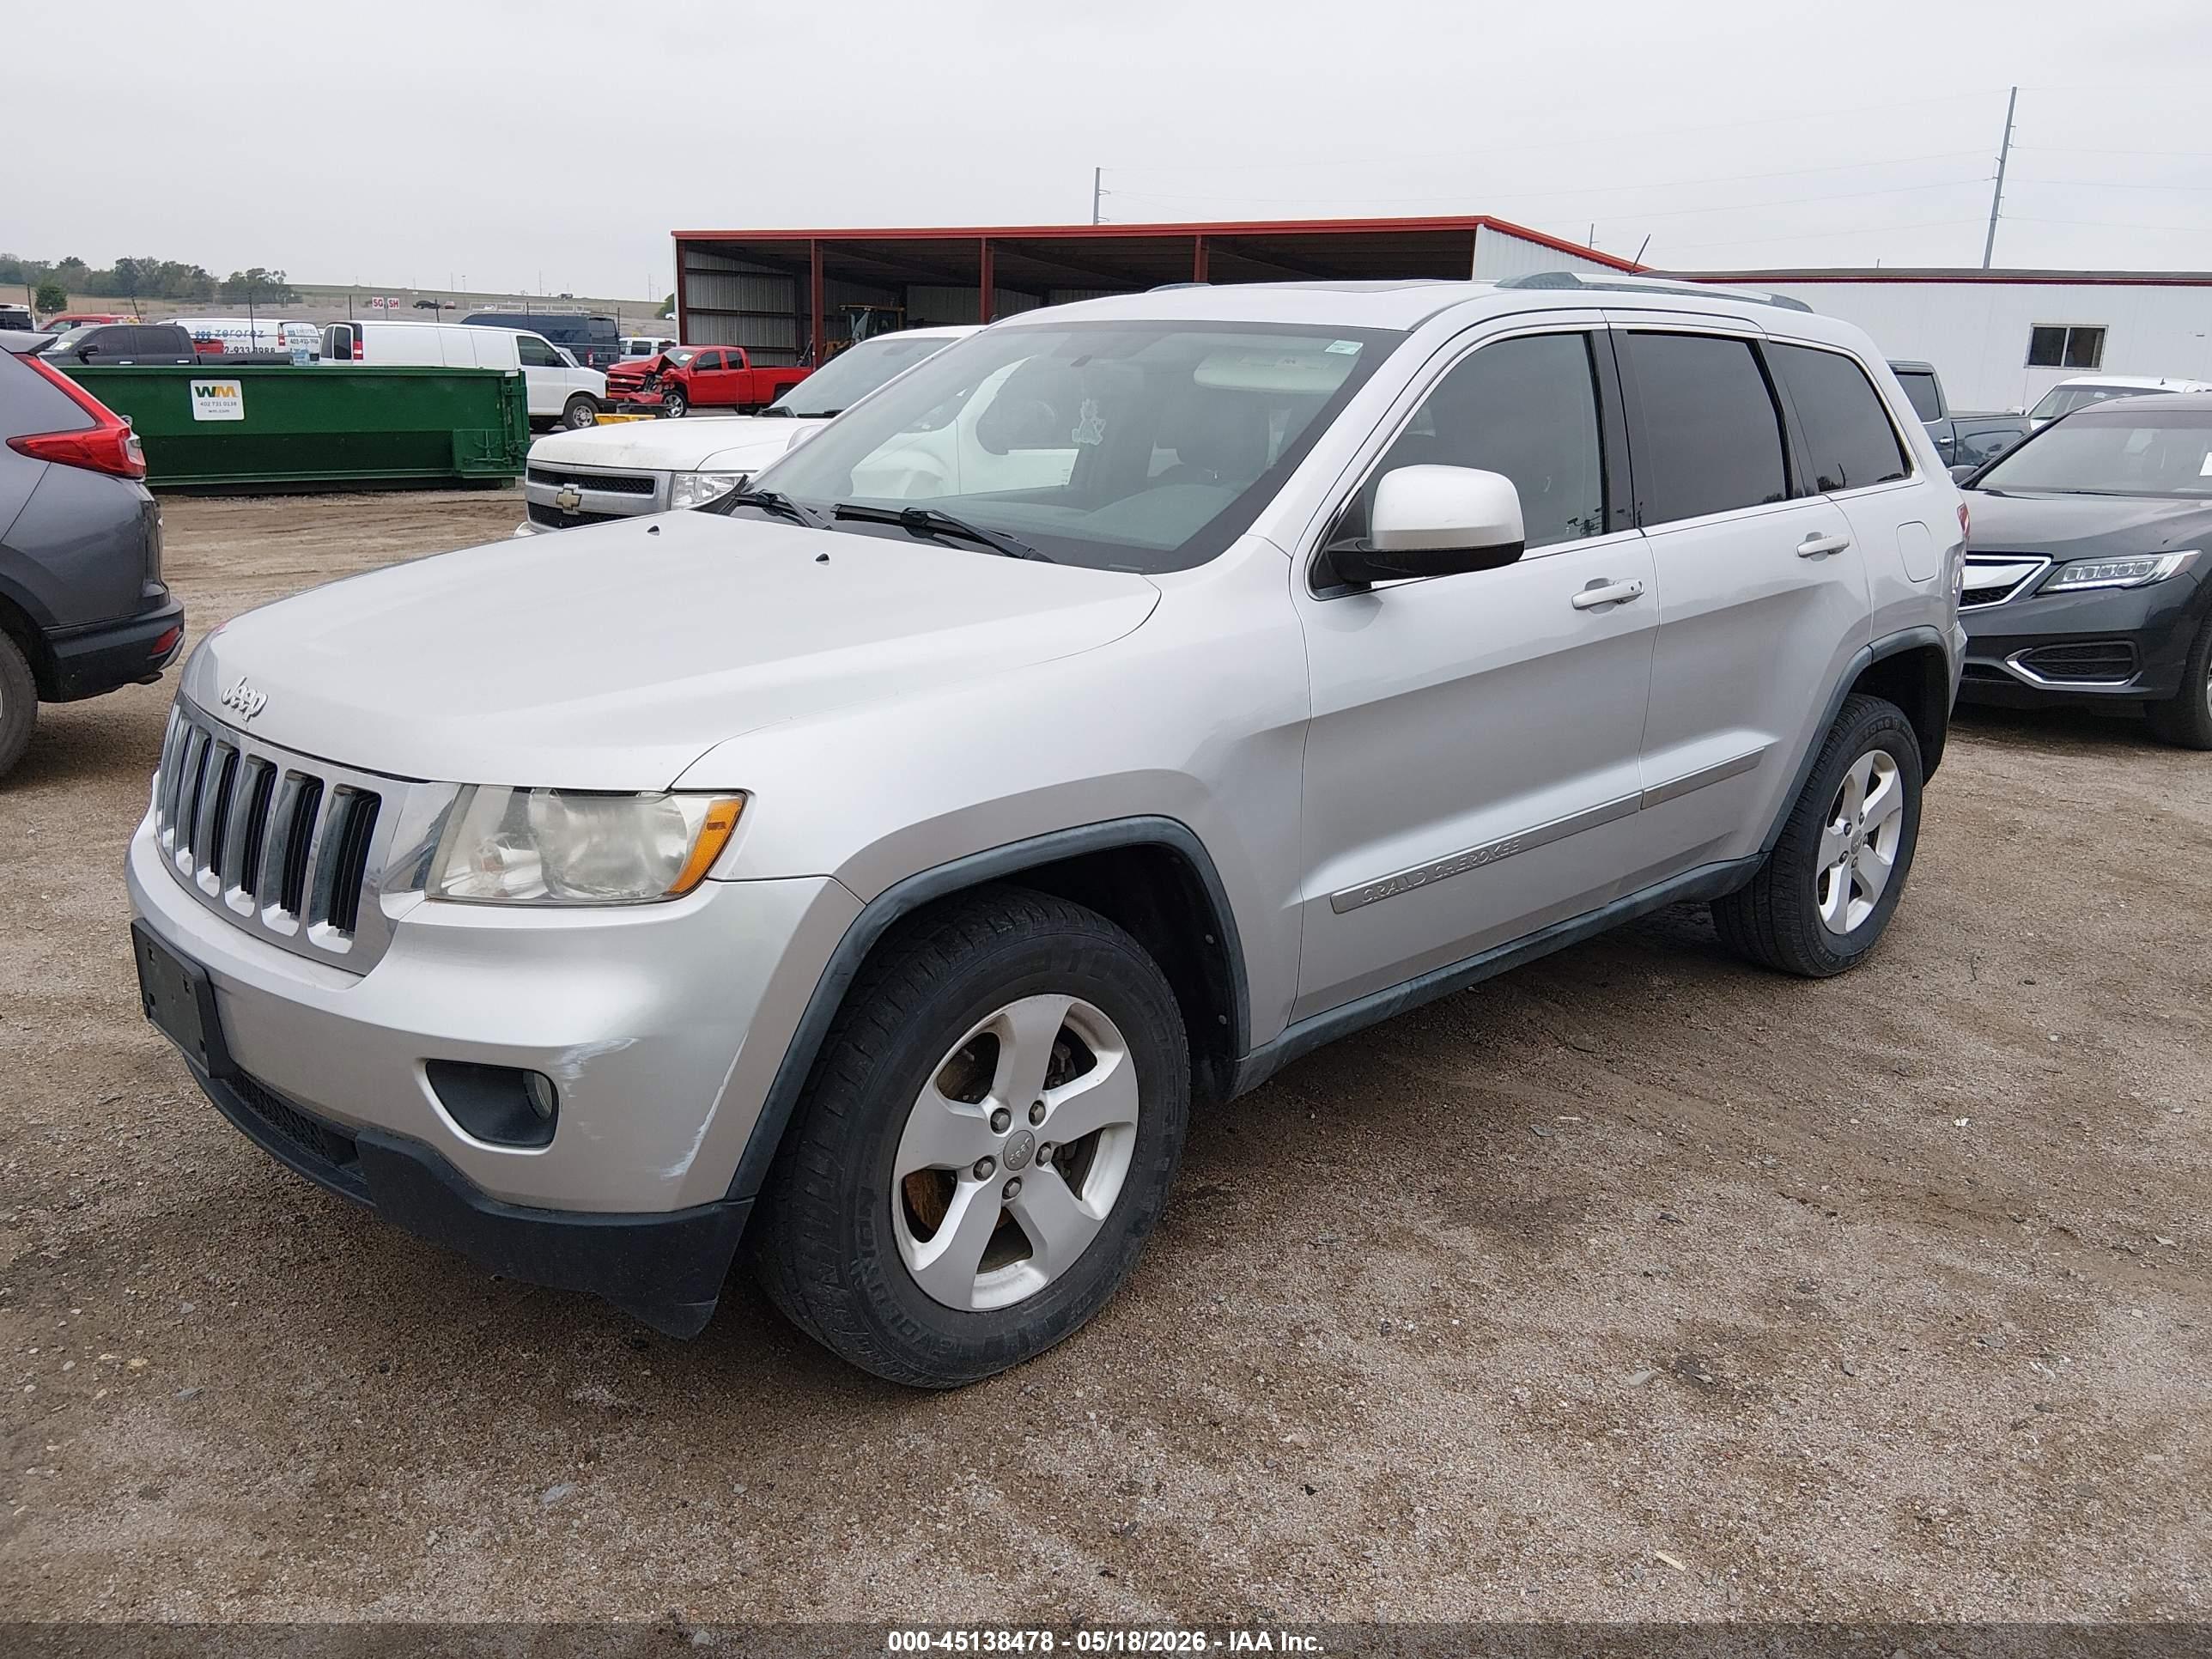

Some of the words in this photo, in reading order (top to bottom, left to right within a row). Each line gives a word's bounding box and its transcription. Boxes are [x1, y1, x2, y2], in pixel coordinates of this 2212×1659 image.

[388, 299, 399, 309] SH
[194, 386, 238, 398] WM
[221, 676, 268, 722] Jeep
[1362, 871, 1427, 902] GRAND
[1434, 839, 1521, 879] CHEROKEE
